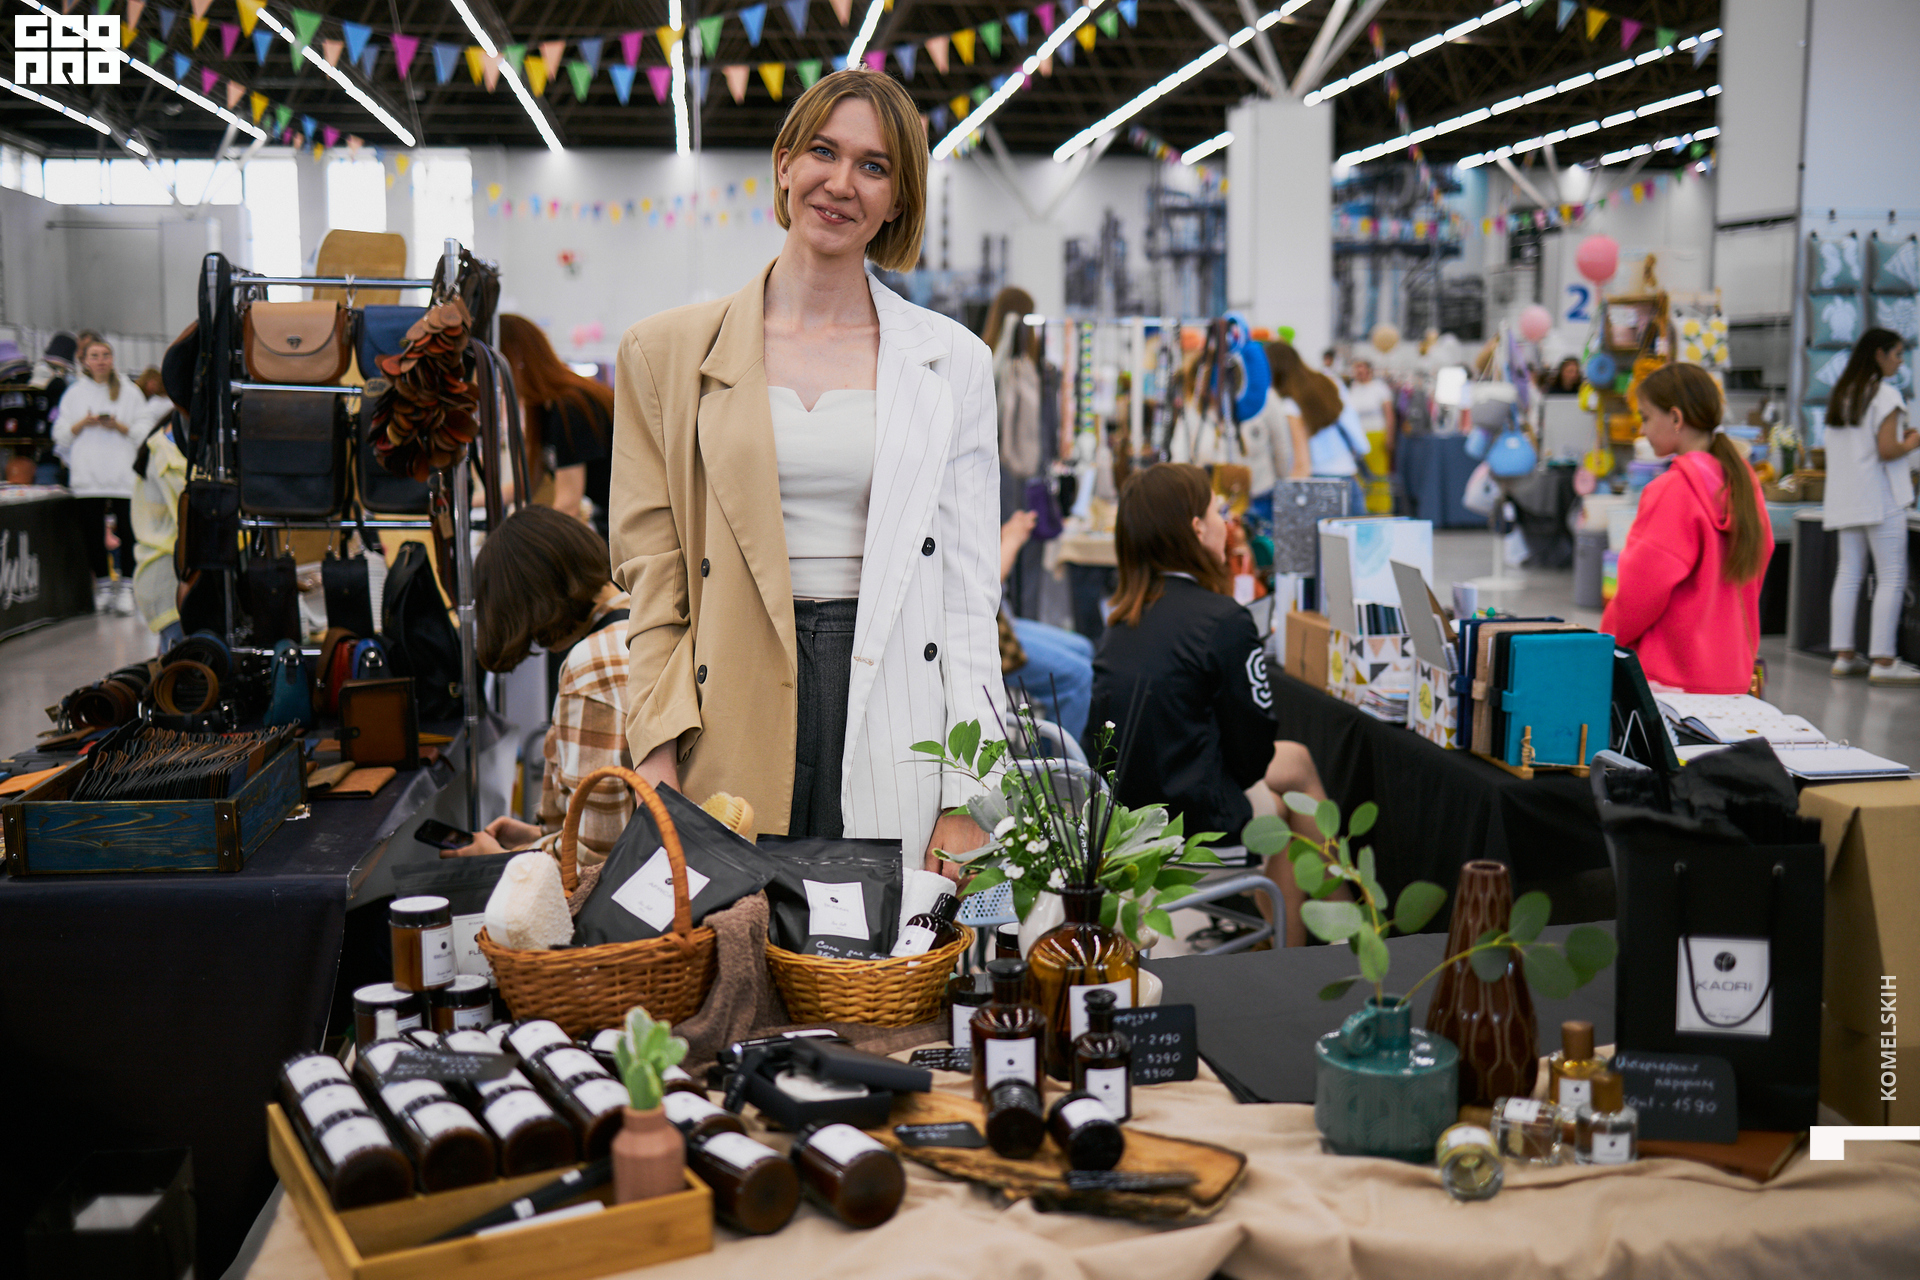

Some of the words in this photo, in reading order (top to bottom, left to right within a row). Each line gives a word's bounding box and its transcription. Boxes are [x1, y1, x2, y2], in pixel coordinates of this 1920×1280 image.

[1568, 284, 1591, 323] 2
[1695, 980, 1753, 992] KAORI
[1149, 1033, 1181, 1046] 2190
[1672, 1097, 1718, 1114] 1590
